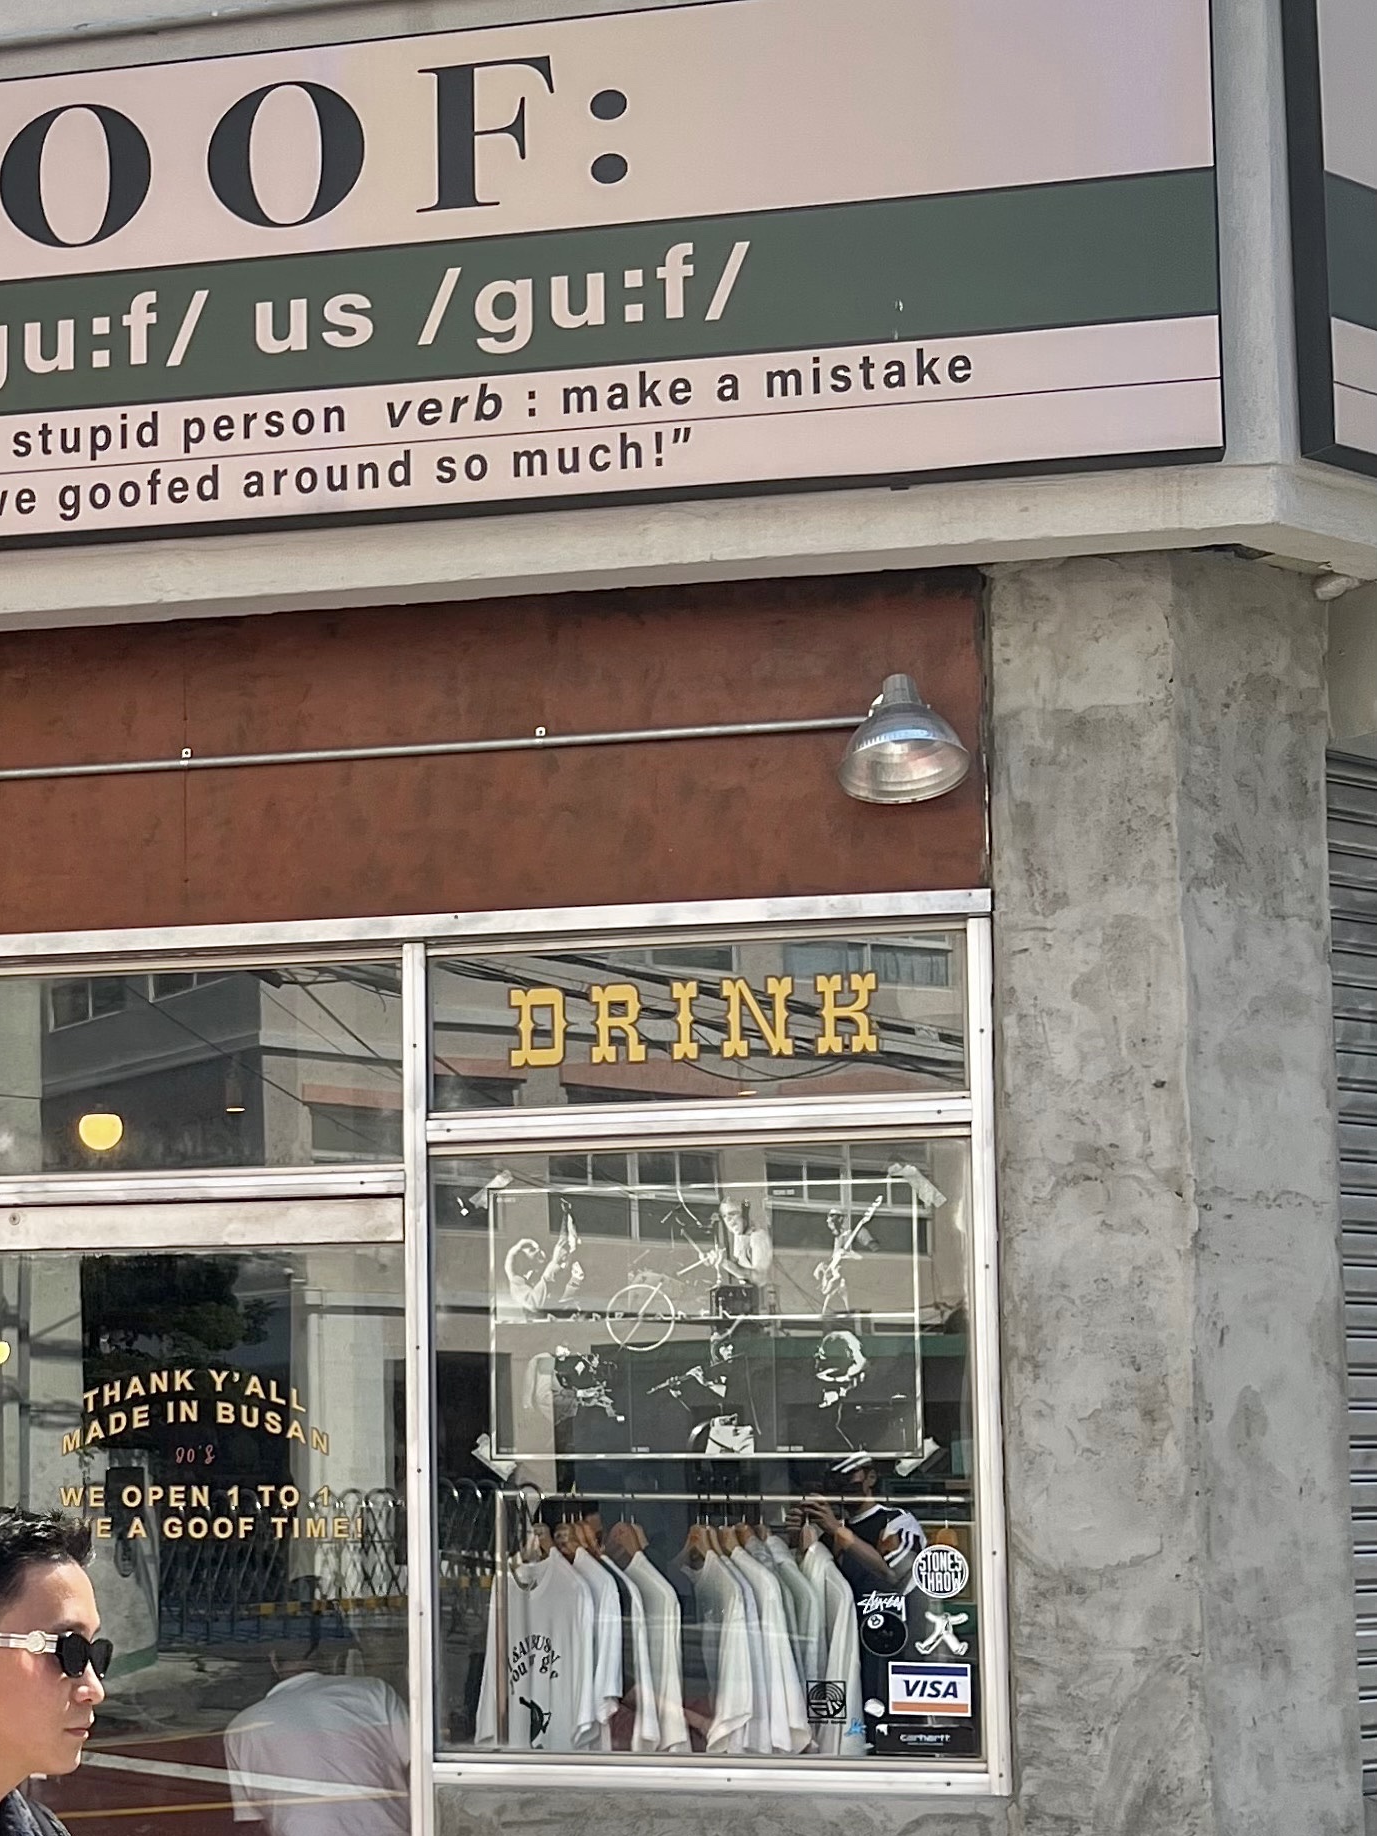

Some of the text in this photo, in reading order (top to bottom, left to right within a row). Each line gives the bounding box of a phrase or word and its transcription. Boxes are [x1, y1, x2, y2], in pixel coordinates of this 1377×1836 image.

[254, 292, 375, 355] us
[12, 410, 160, 462] stupid
[183, 405, 346, 454] person
[386, 382, 504, 429] verb
[562, 370, 692, 415] make
[716, 373, 740, 402] a
[766, 347, 972, 398] mistake
[58, 463, 219, 522] goofed
[243, 448, 411, 498] around
[436, 453, 488, 484] so
[508, 971, 879, 1068] DRINK
[82, 1368, 196, 1414] THANK
[60, 1399, 330, 1456] MADE IN BUSAN
[59, 1486, 106, 1508] WE
[121, 1485, 210, 1508] OPEN
[225, 1485, 241, 1508] 1
[257, 1485, 301, 1508] TO
[126, 1516, 148, 1539] A
[162, 1515, 256, 1540] GOOF
[270, 1516, 365, 1540] TIME!
[918, 1550, 963, 1573] STONES
[919, 1570, 963, 1593] THROW
[903, 1679, 959, 1699] VISA
